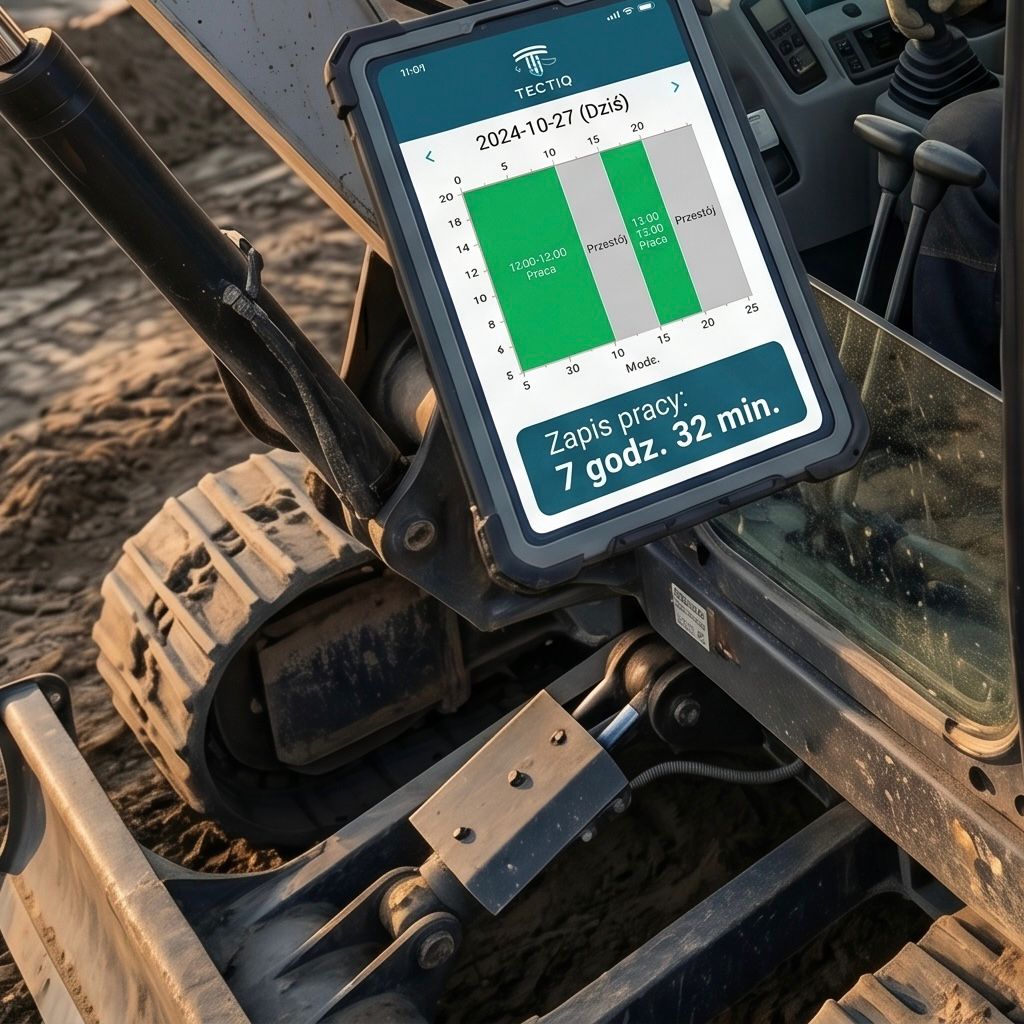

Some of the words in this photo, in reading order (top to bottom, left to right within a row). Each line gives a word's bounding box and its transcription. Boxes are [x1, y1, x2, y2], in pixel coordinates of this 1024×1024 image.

[514, 75, 573, 99] TECTIQ
[475, 108, 574, 151] 2024-10-27
[580, 93, 630, 124] (Dziś)
[454, 175, 462, 185] 0
[501, 162, 508, 171] 5
[543, 148, 556, 158] 10
[587, 134, 600, 146] 15
[630, 121, 645, 133] 20
[439, 192, 454, 204] 20
[674, 204, 717, 225] Przestój
[456, 243, 470, 254] 14
[586, 234, 629, 254] Przestój
[640, 235, 668, 250] Praca
[465, 268, 480, 279] 12
[526, 265, 557, 281] Praca
[473, 293, 488, 305] 10
[488, 320, 496, 329] 8
[523, 380, 531, 391] 5
[565, 363, 581, 376] 30
[611, 348, 626, 360] 10
[657, 332, 671, 345] 15
[701, 317, 716, 329] 20
[744, 302, 760, 315] 25
[544, 417, 613, 456] Zapis
[617, 389, 688, 436] pracy:
[555, 461, 574, 491] 7
[586, 437, 668, 488] godz.
[672, 414, 713, 448] 32
[716, 396, 780, 432] min.
